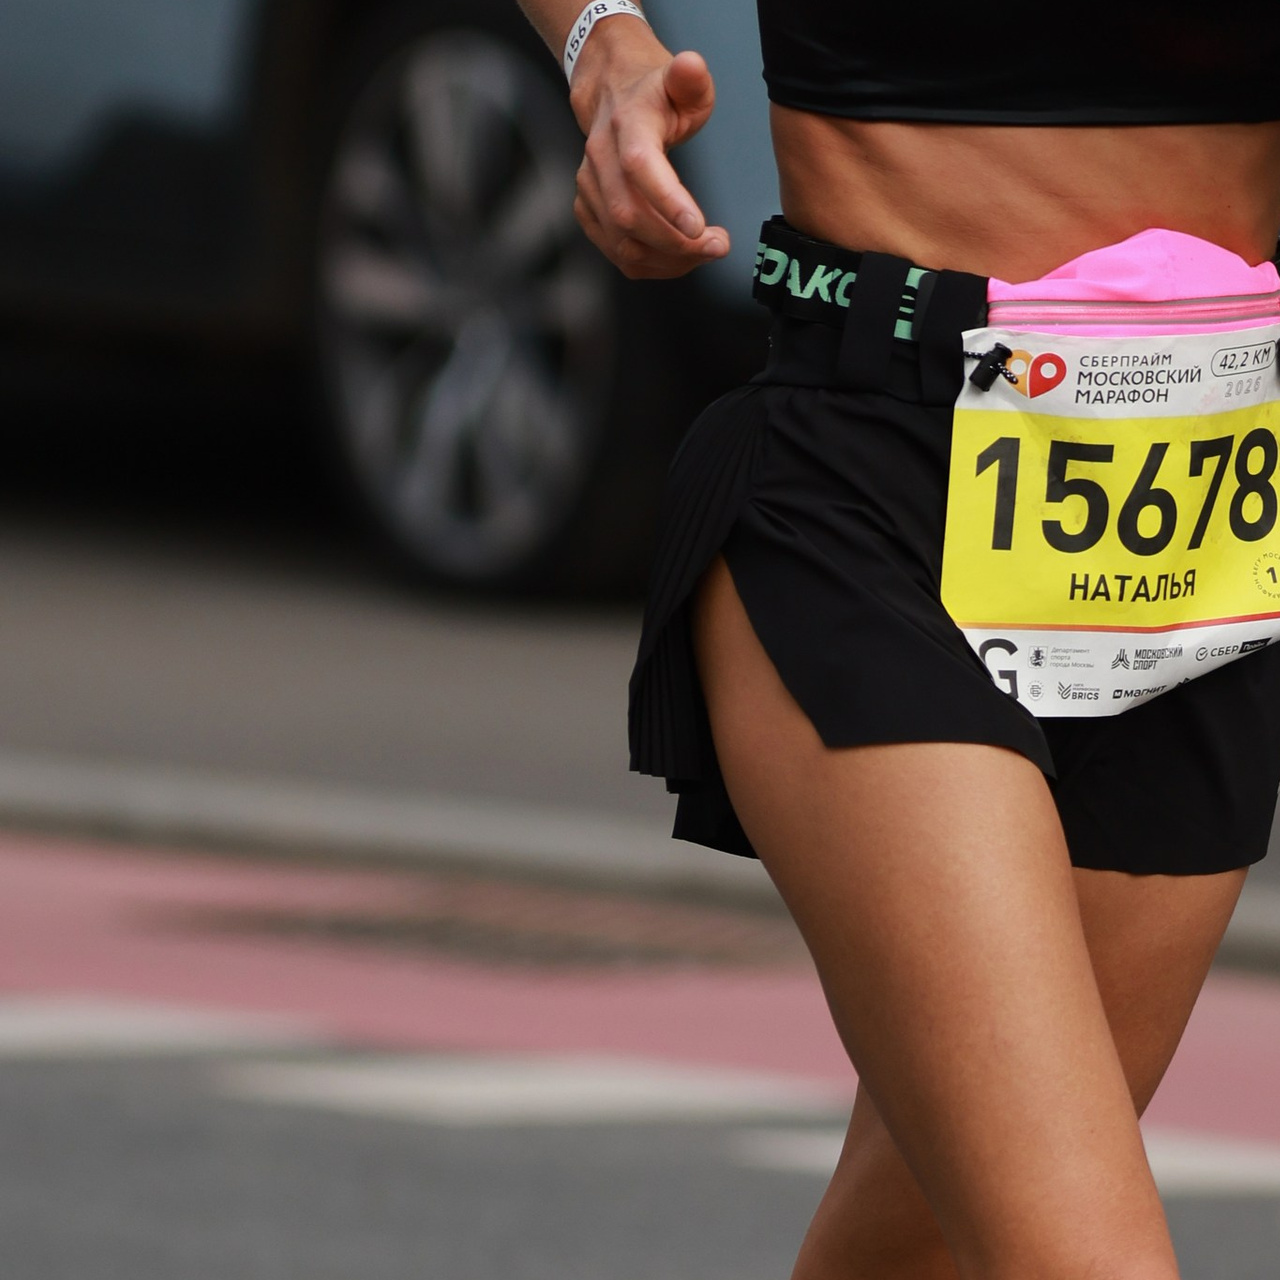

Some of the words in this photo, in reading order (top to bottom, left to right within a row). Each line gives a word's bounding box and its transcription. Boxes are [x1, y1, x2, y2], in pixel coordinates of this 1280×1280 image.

[567, 3, 608, 63] 15678
[1080, 352, 1172, 367] СБЕРПРАЙМ
[1219, 351, 1249, 370] 42,2
[1077, 365, 1201, 386] МОСКОВСКИЙ
[1075, 388, 1169, 404] МАРАФОН
[974, 427, 1279, 557] 15678
[1266, 566, 1278, 584] 1
[1069, 568, 1196, 602] НАТАЛЬЯ
[1133, 644, 1183, 660] МОСКОВСКИЙ
[1210, 645, 1239, 657] СБЕР
[1133, 660, 1158, 670] СПОРТ
[1071, 692, 1100, 701] BRICS
